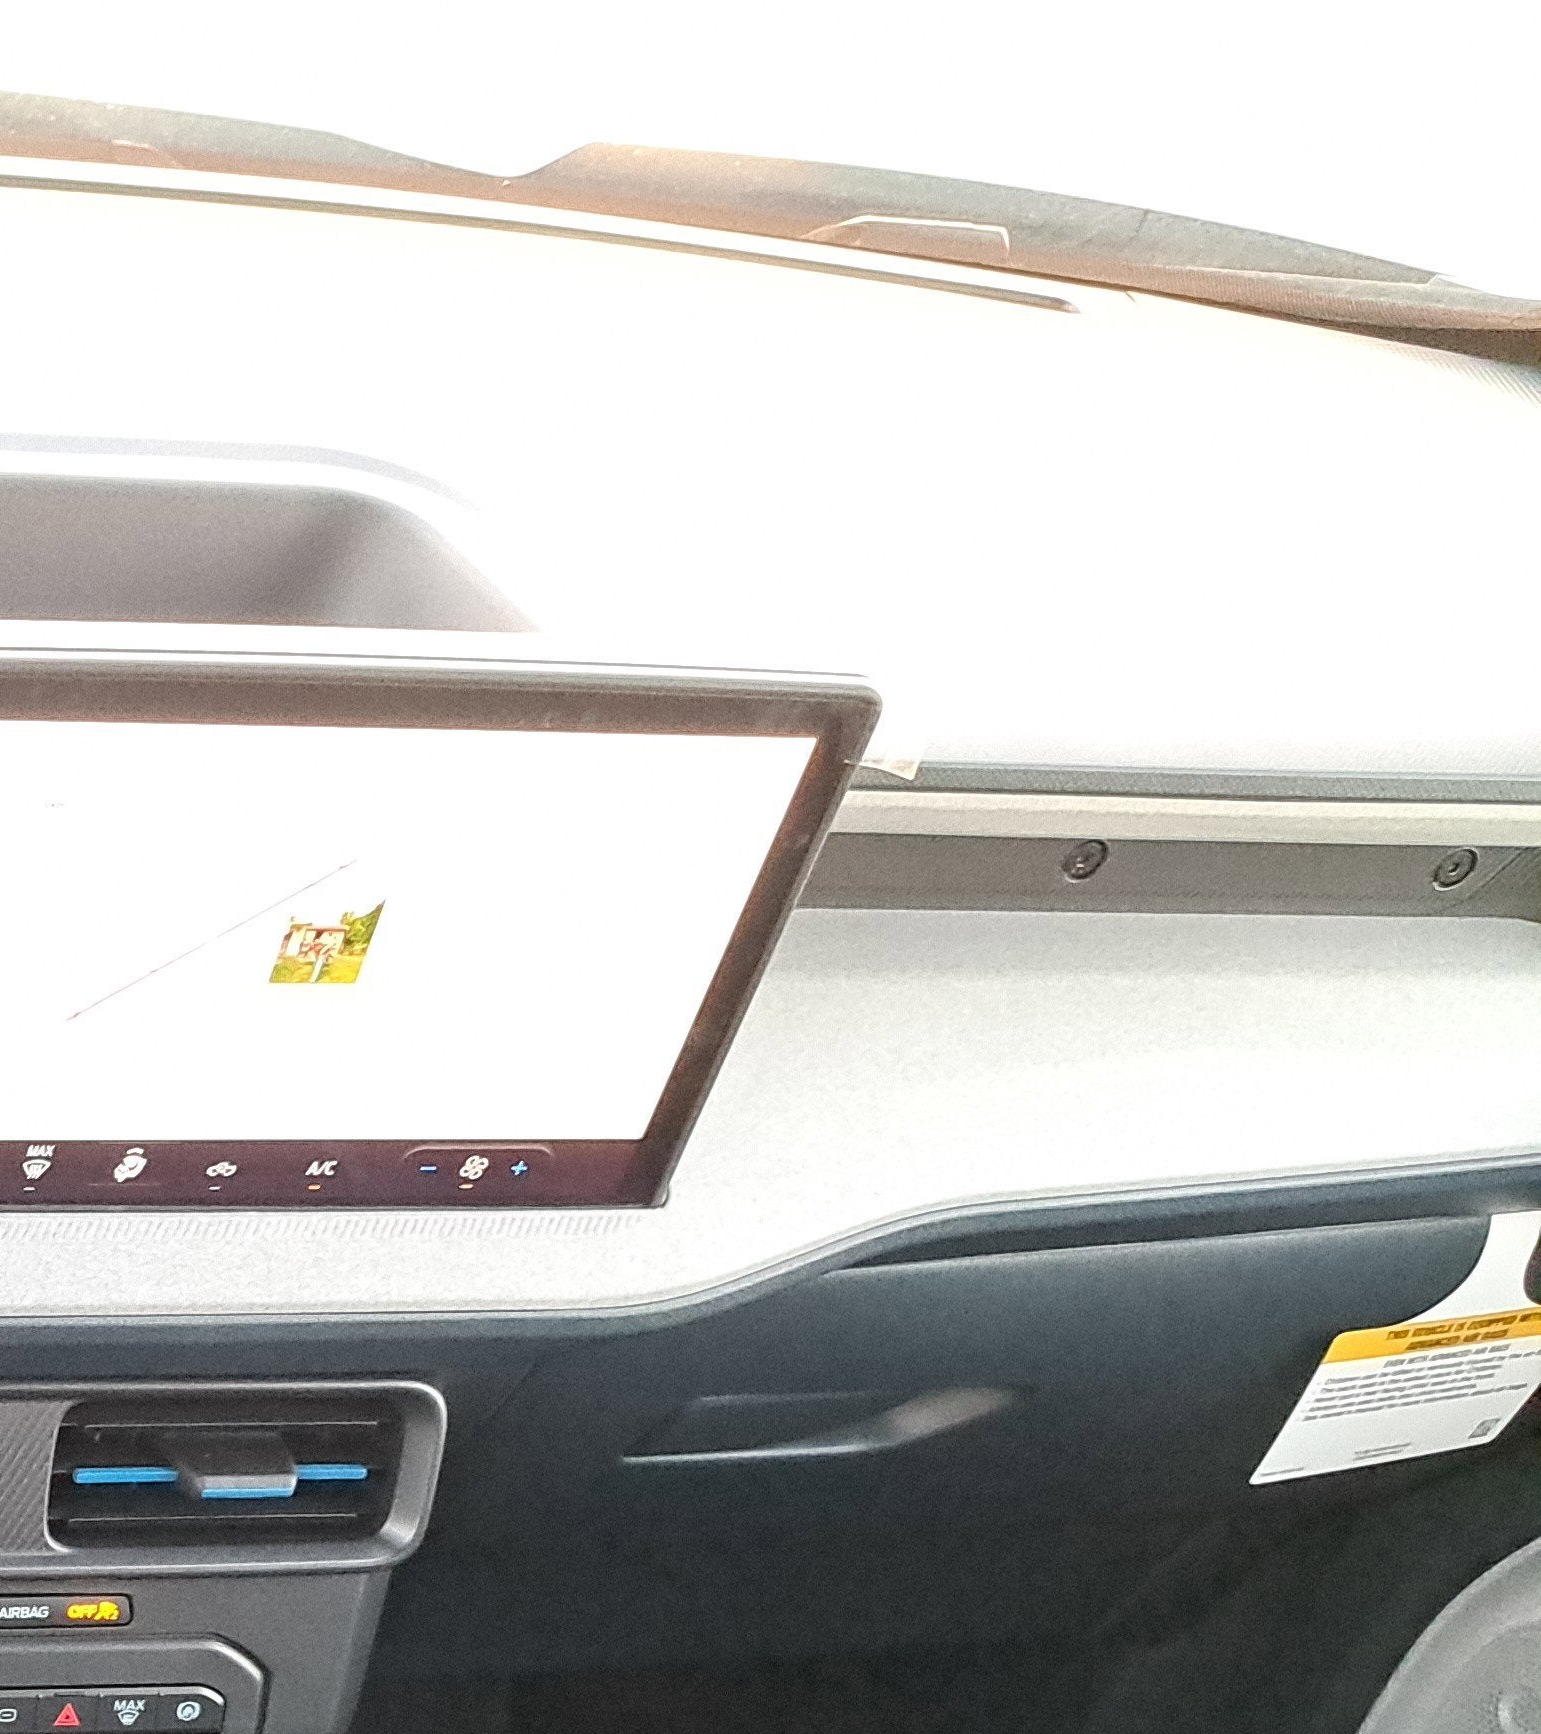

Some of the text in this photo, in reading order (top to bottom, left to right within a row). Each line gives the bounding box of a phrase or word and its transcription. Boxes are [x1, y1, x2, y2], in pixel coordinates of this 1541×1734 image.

[25, 1144, 55, 1158] MAX
[305, 1159, 338, 1177] A/C
[66, 1604, 98, 1619] OFF
[113, 1699, 146, 1711] MAX
